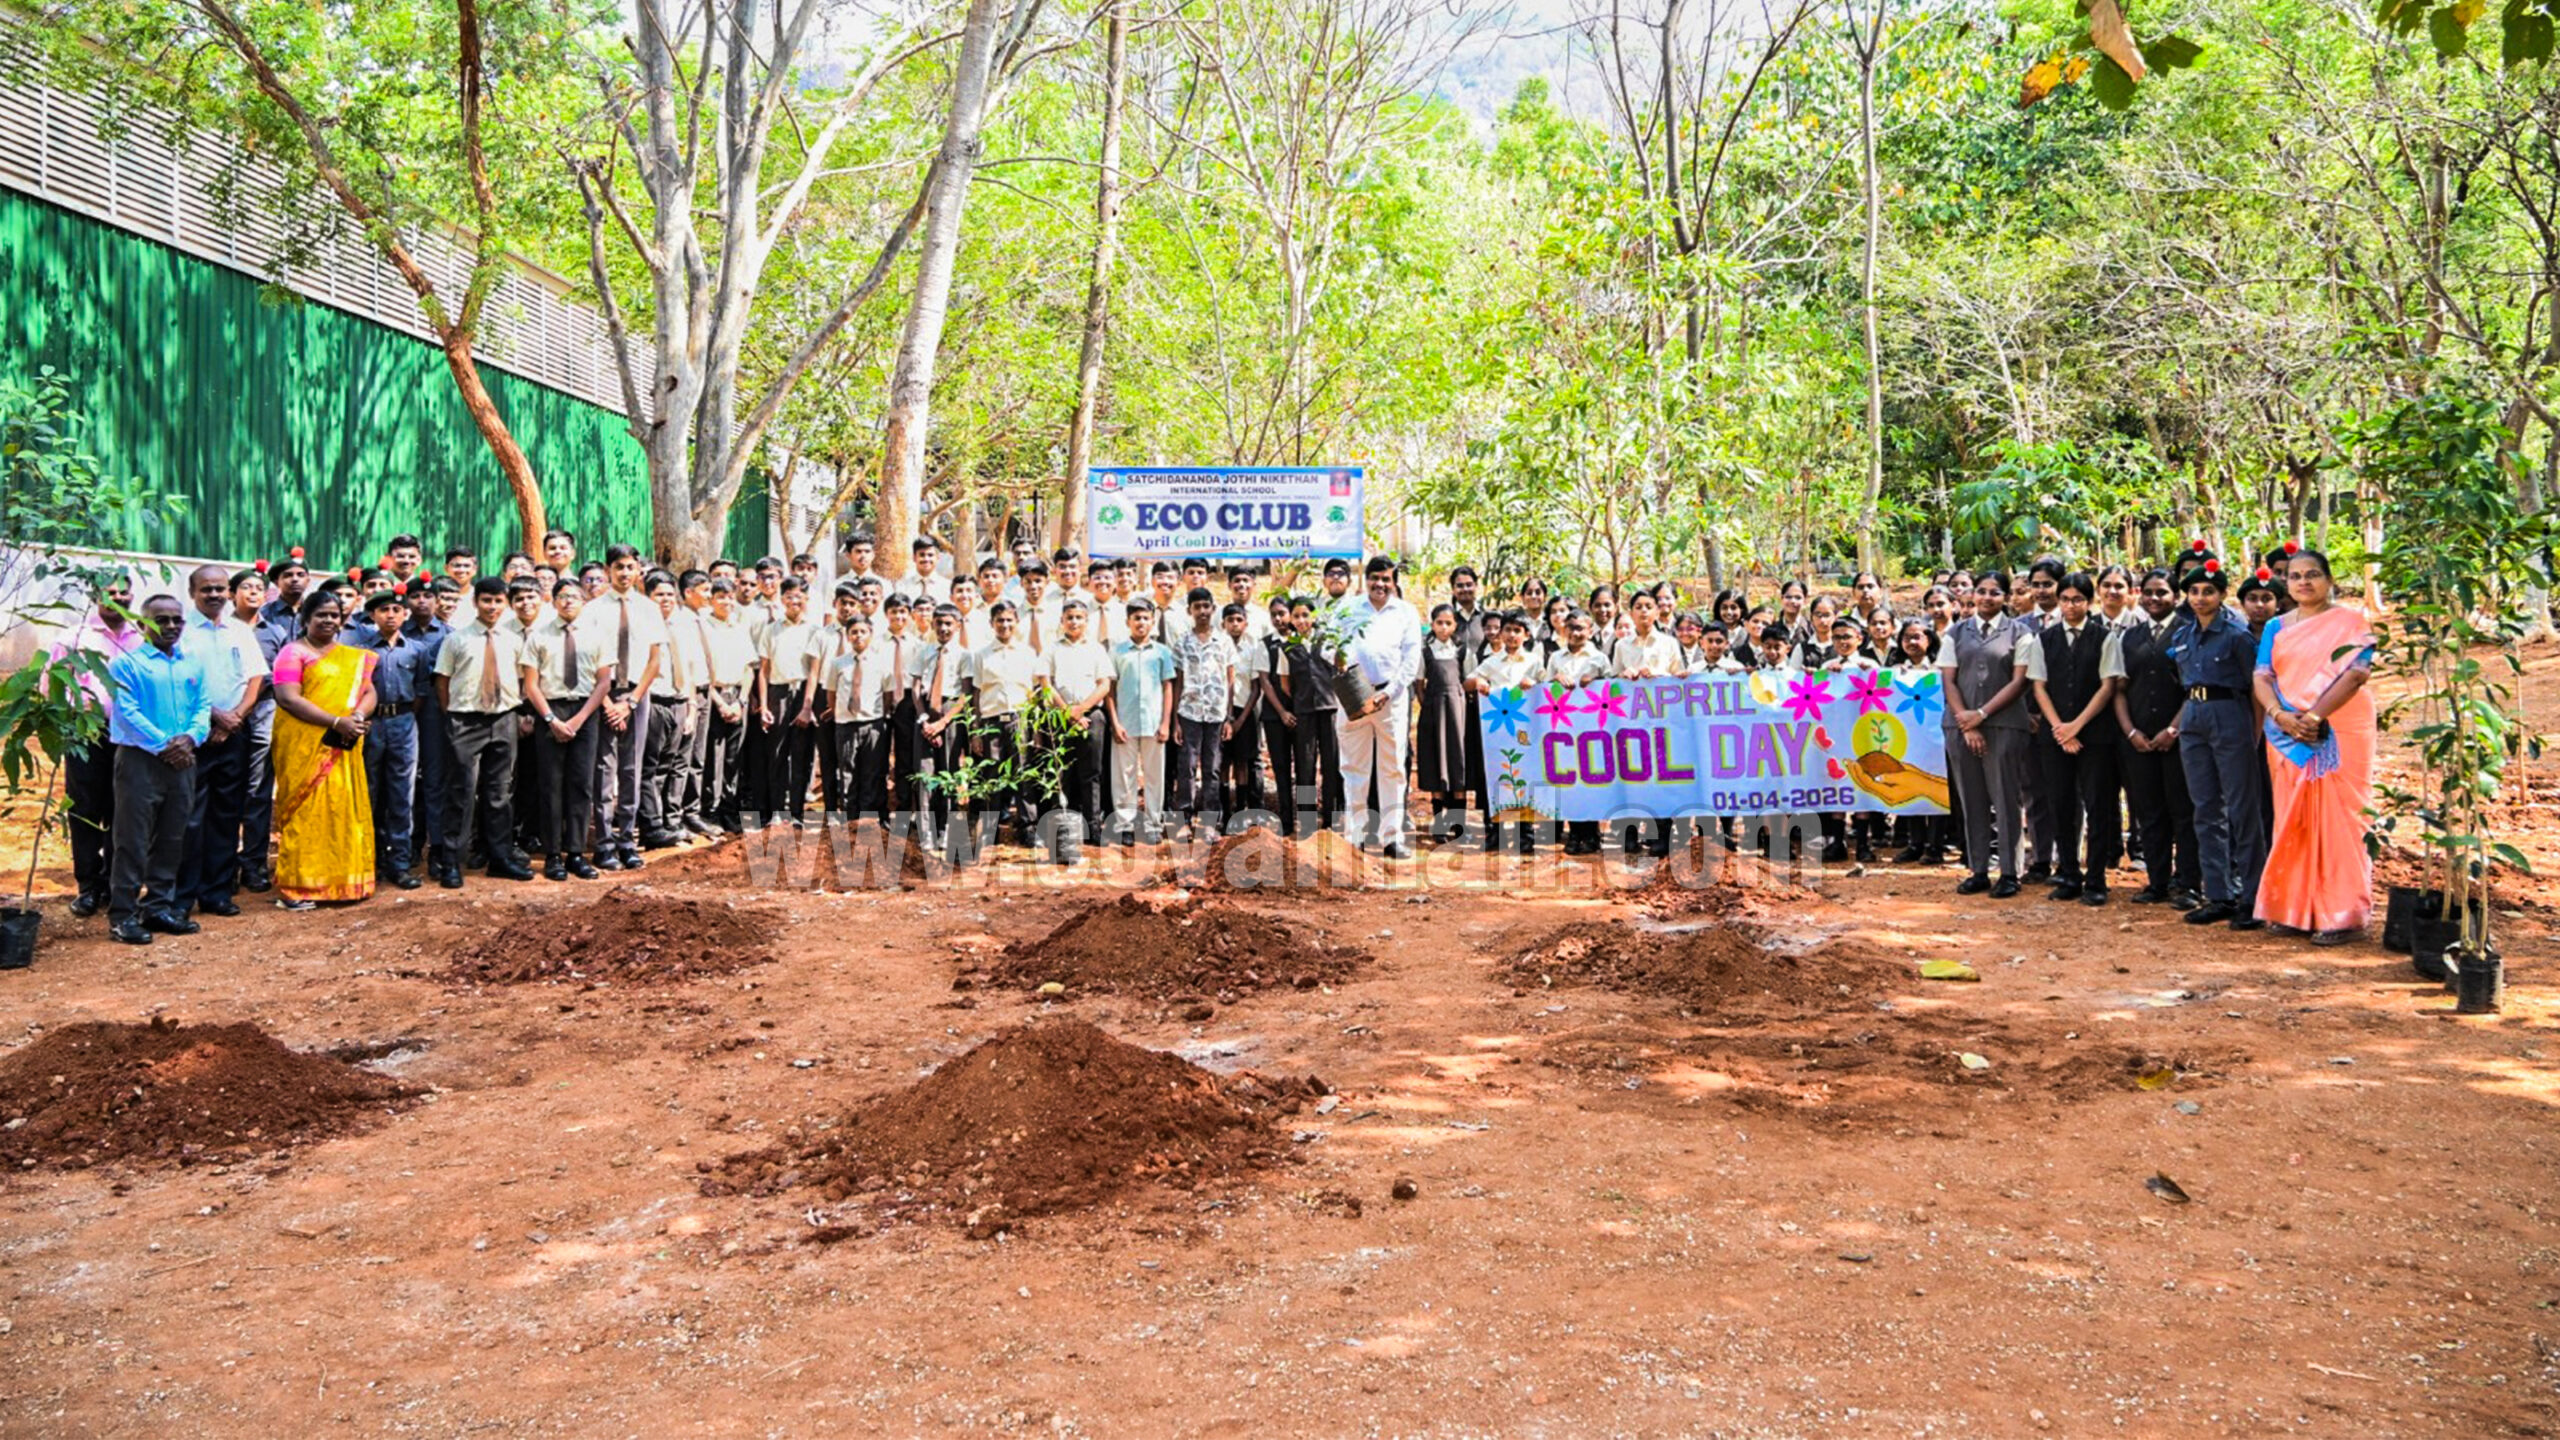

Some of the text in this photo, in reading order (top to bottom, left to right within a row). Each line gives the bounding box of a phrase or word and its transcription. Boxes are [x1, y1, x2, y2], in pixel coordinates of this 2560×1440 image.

[1126, 474, 1319, 484] SATCHIDANANDA JOTHI NIKETHAN
[1170, 486, 1276, 495] INTERNATIONAL SCHOOL
[1135, 502, 1312, 531] ECO CLUB
[1135, 535, 1170, 548] April
[1174, 535, 1206, 547] Cool
[1210, 535, 1237, 550] Day
[1252, 535, 1270, 547] 1st
[1630, 681, 1756, 720] APRIL
[1541, 721, 1812, 786] COOL DAY
[1712, 787, 1856, 811] 01-04-2026
